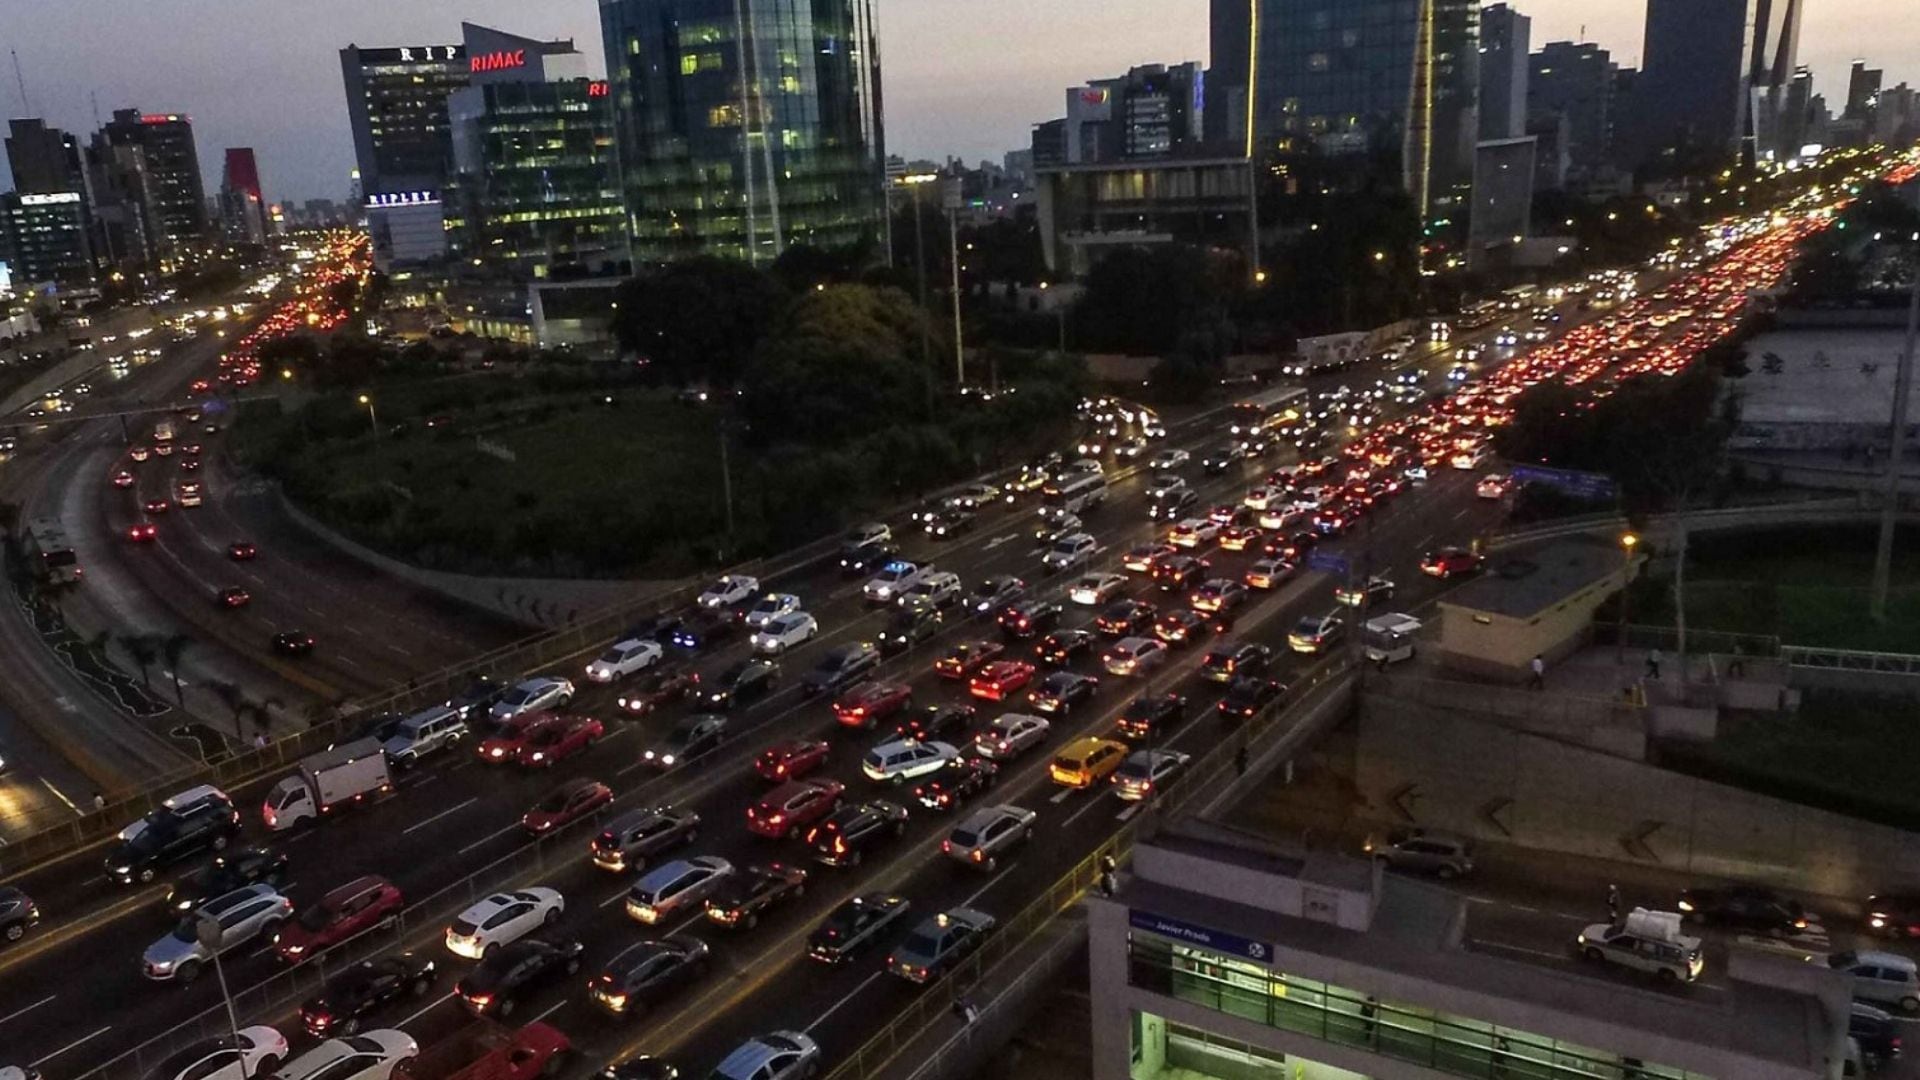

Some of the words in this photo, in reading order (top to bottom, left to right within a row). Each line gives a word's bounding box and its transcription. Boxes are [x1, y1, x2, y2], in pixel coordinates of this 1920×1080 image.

[471, 49, 525, 72] RIMAC
[369, 191, 431, 205] RIPLEY
[1156, 921, 1184, 935] Javier
[1184, 928, 1211, 942] Prado
